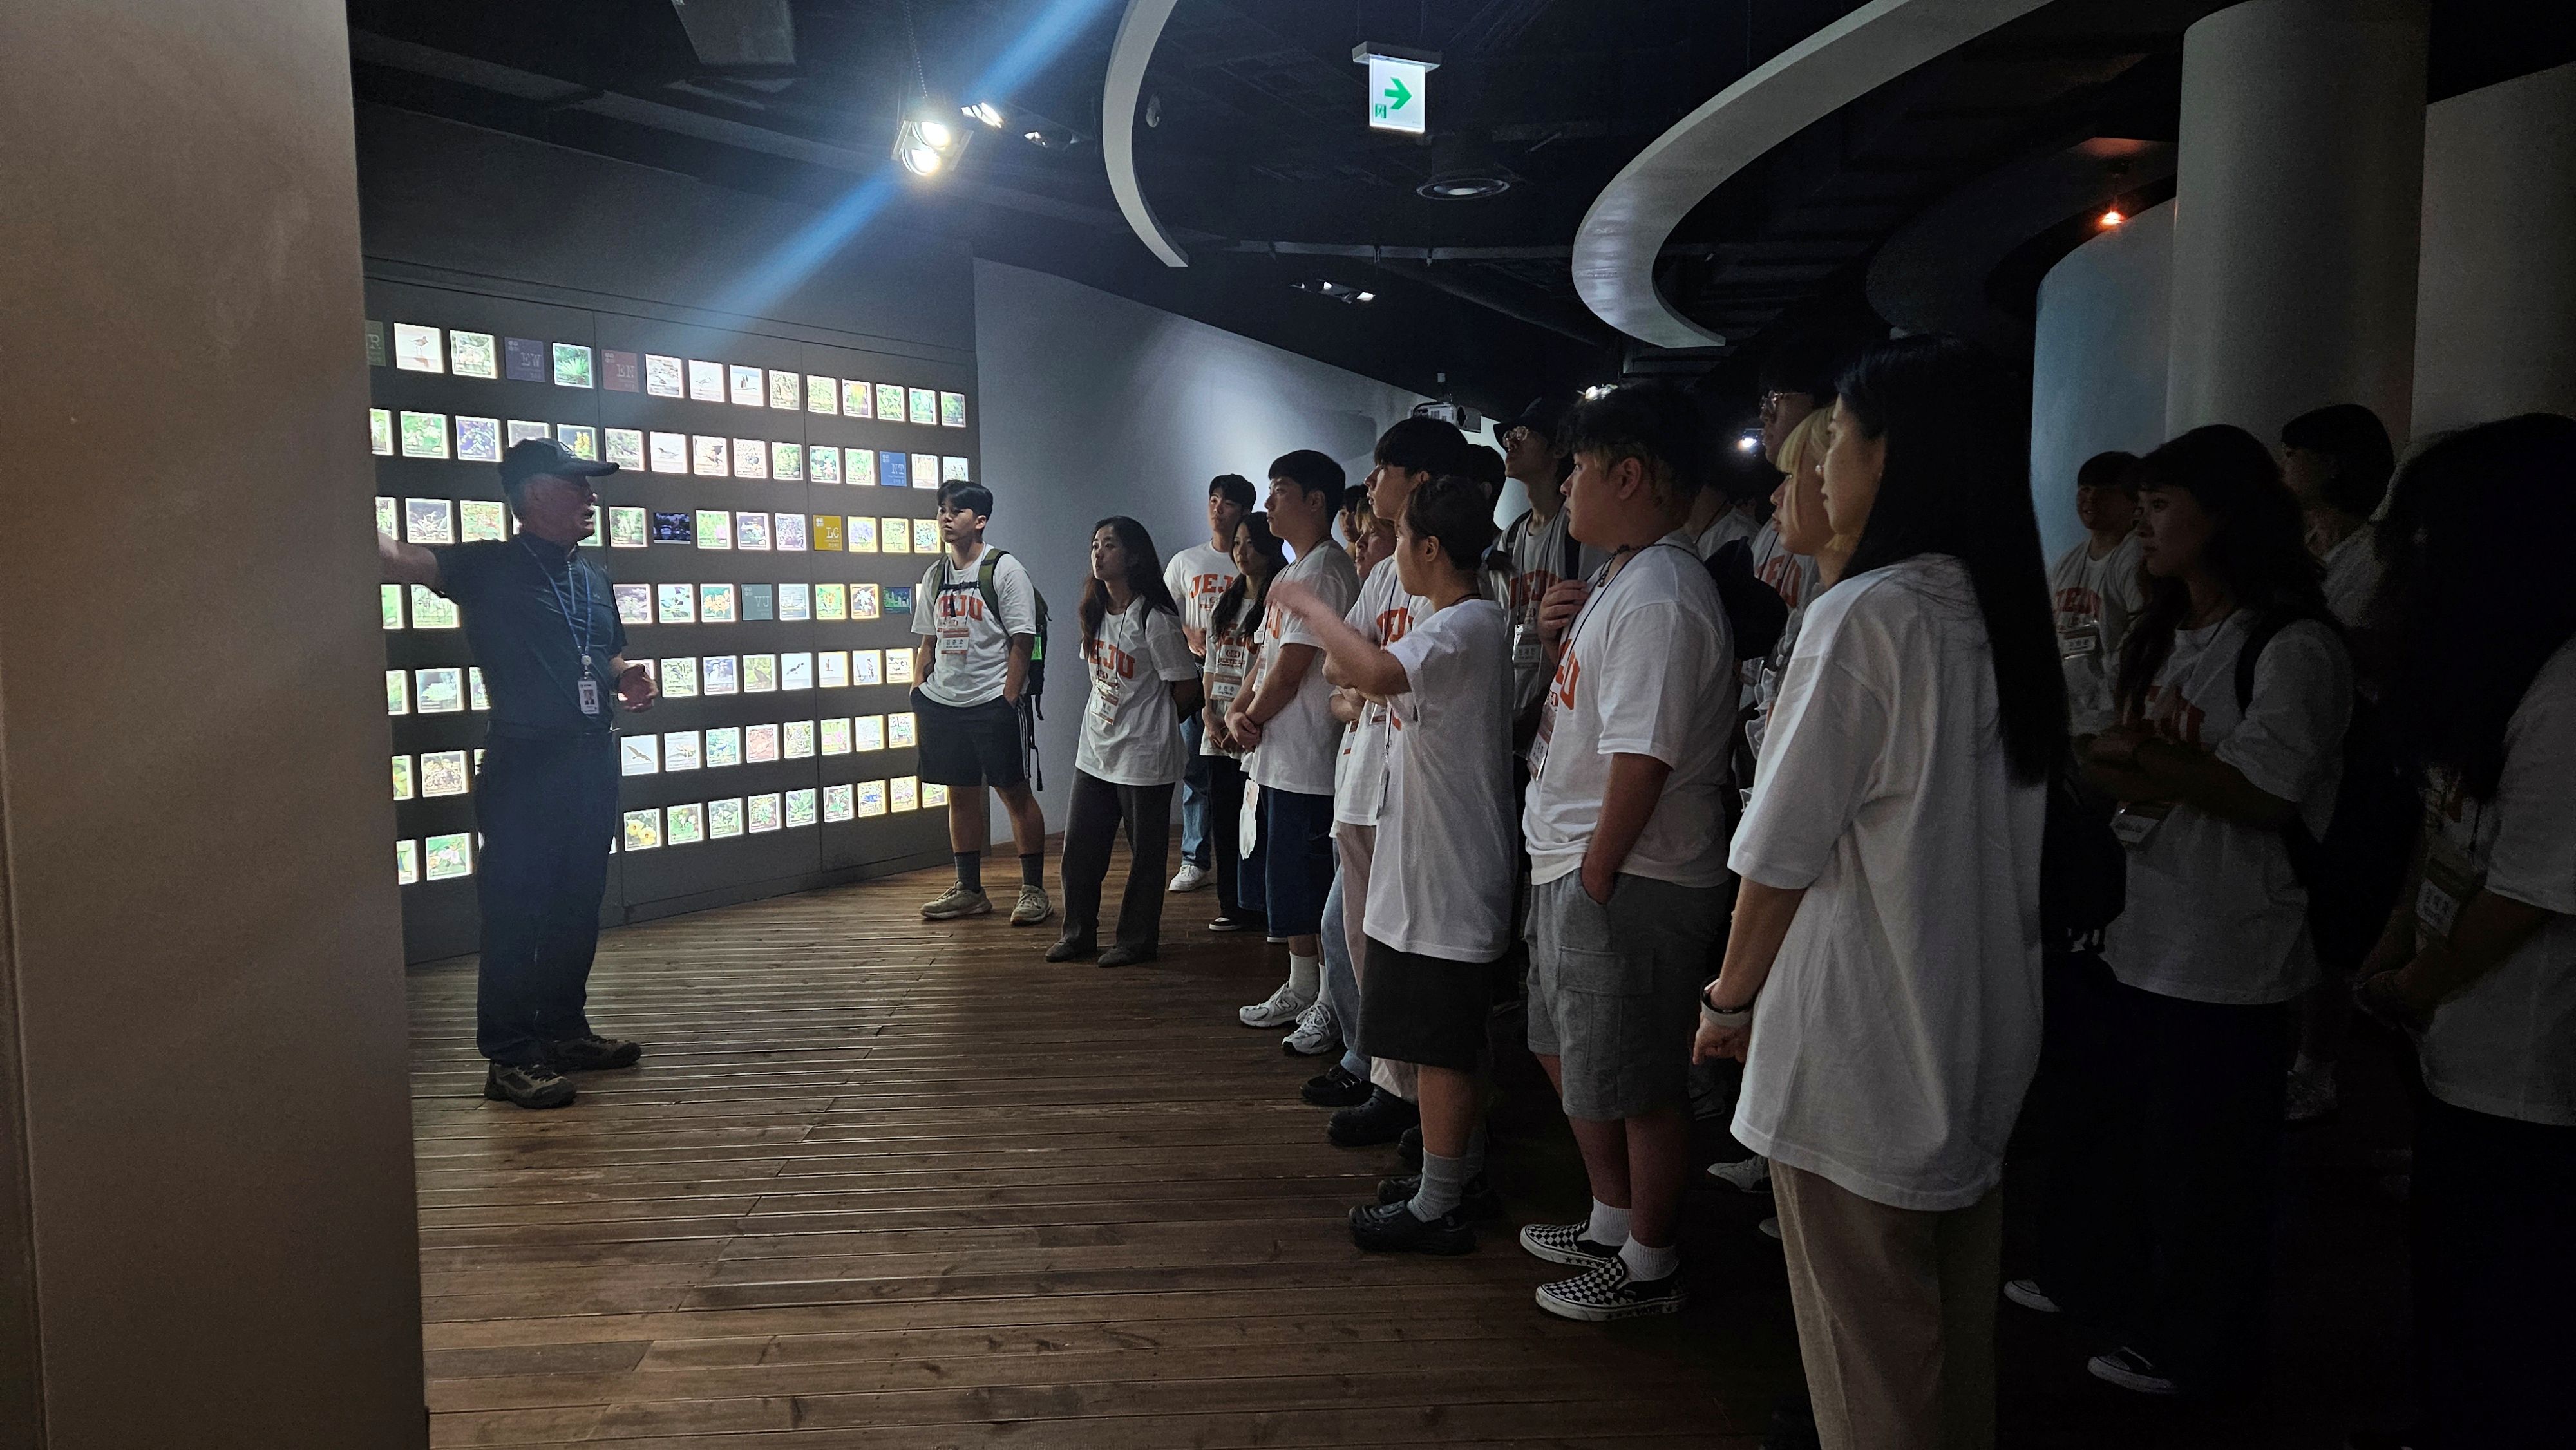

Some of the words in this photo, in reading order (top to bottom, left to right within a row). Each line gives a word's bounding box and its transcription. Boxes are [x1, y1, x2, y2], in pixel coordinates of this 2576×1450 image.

[616, 364, 635, 378] EN
[891, 463, 904, 475] NT
[826, 527, 840, 538] LC
[1190, 574, 1233, 599] JEJ
[1090, 639, 1135, 679] EJU
